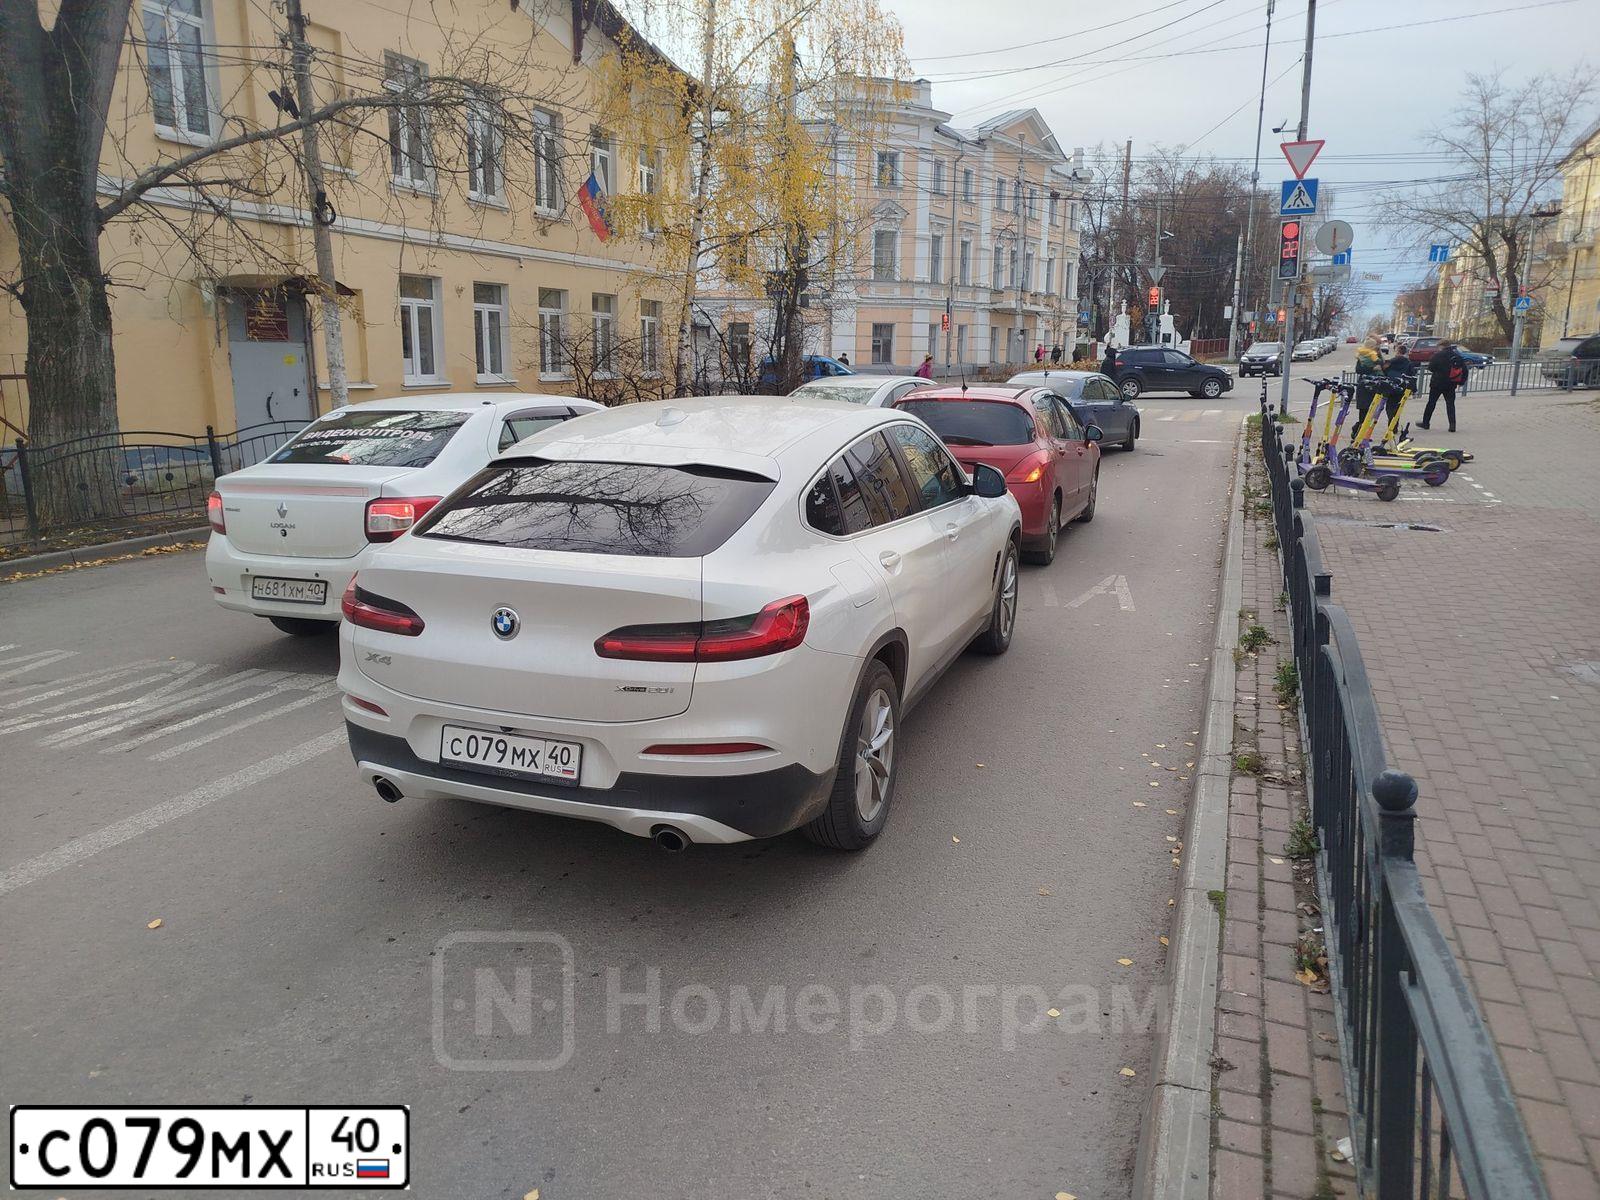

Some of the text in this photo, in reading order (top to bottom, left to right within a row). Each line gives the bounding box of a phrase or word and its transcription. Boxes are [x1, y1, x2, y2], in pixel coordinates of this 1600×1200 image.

[1282, 240, 1299, 259] 22
[301, 427, 435, 442] ВИДЕОКОНТРОЛЬ
[269, 522, 296, 530] LOGAN
[257, 581, 321, 599] Н681ХМ 40
[364, 651, 393, 666] X4
[450, 734, 571, 770] С079МХ 40
[544, 763, 562, 774] RUS
